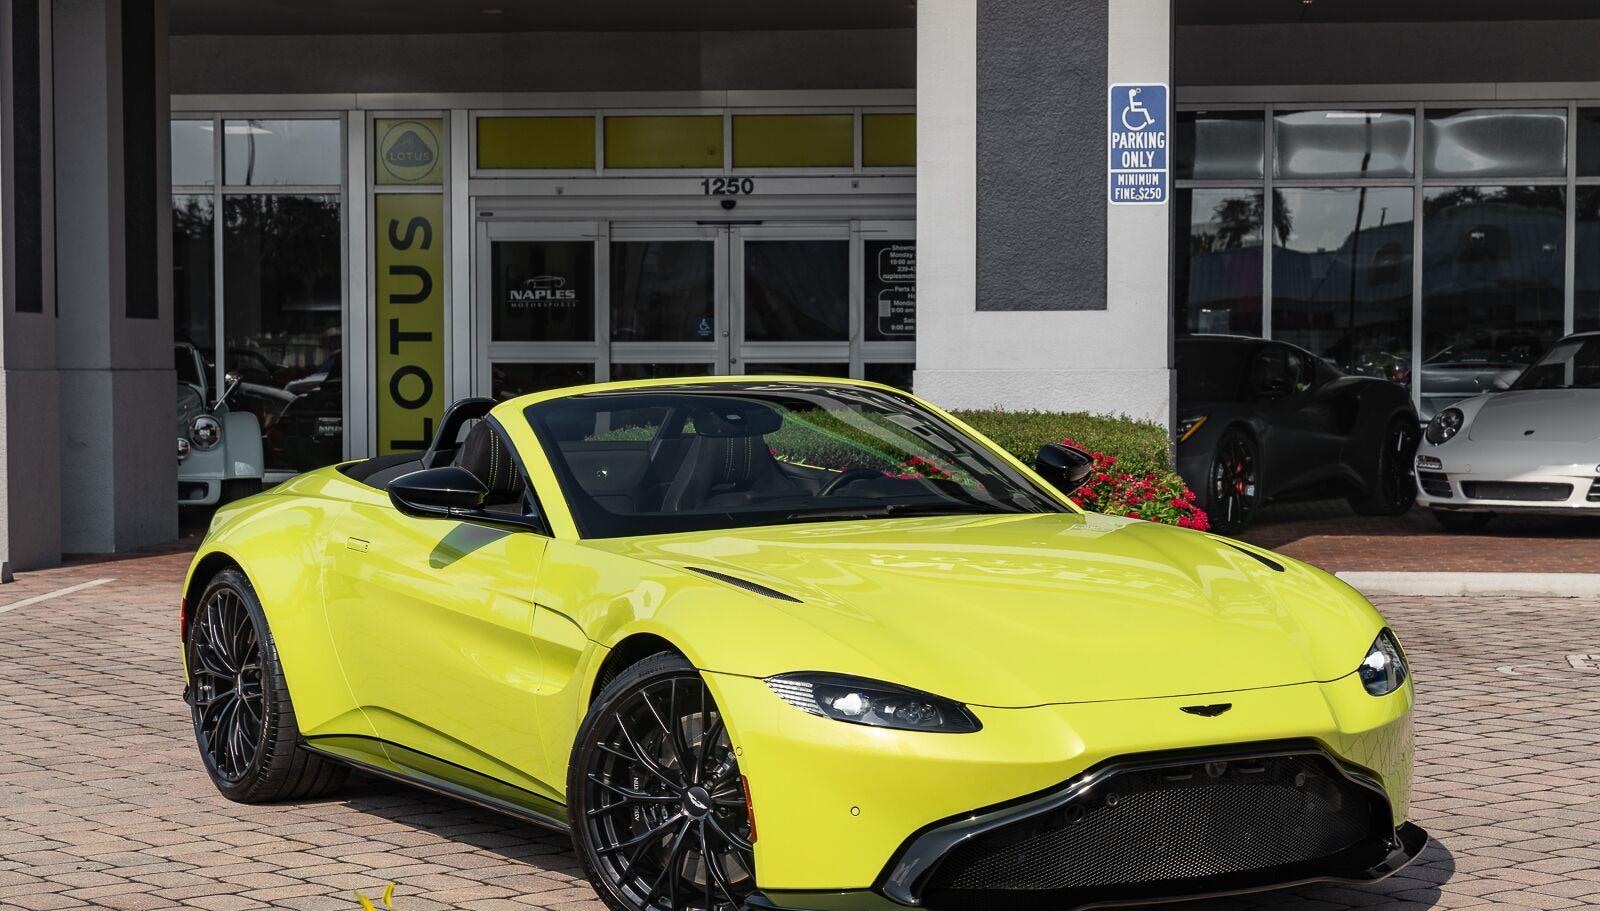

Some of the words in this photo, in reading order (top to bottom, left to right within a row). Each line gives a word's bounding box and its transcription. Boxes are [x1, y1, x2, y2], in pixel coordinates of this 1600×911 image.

[1112, 132, 1165, 149] PARKING
[390, 151, 430, 161] LOTUS
[1121, 150, 1155, 168] ONLY
[701, 178, 754, 195] 1250
[1117, 173, 1159, 186] MINIMUM
[1115, 188, 1136, 200] FINE
[1139, 187, 1162, 201] $250
[510, 289, 576, 300] NAPLES
[388, 216, 433, 450] LOTUS
